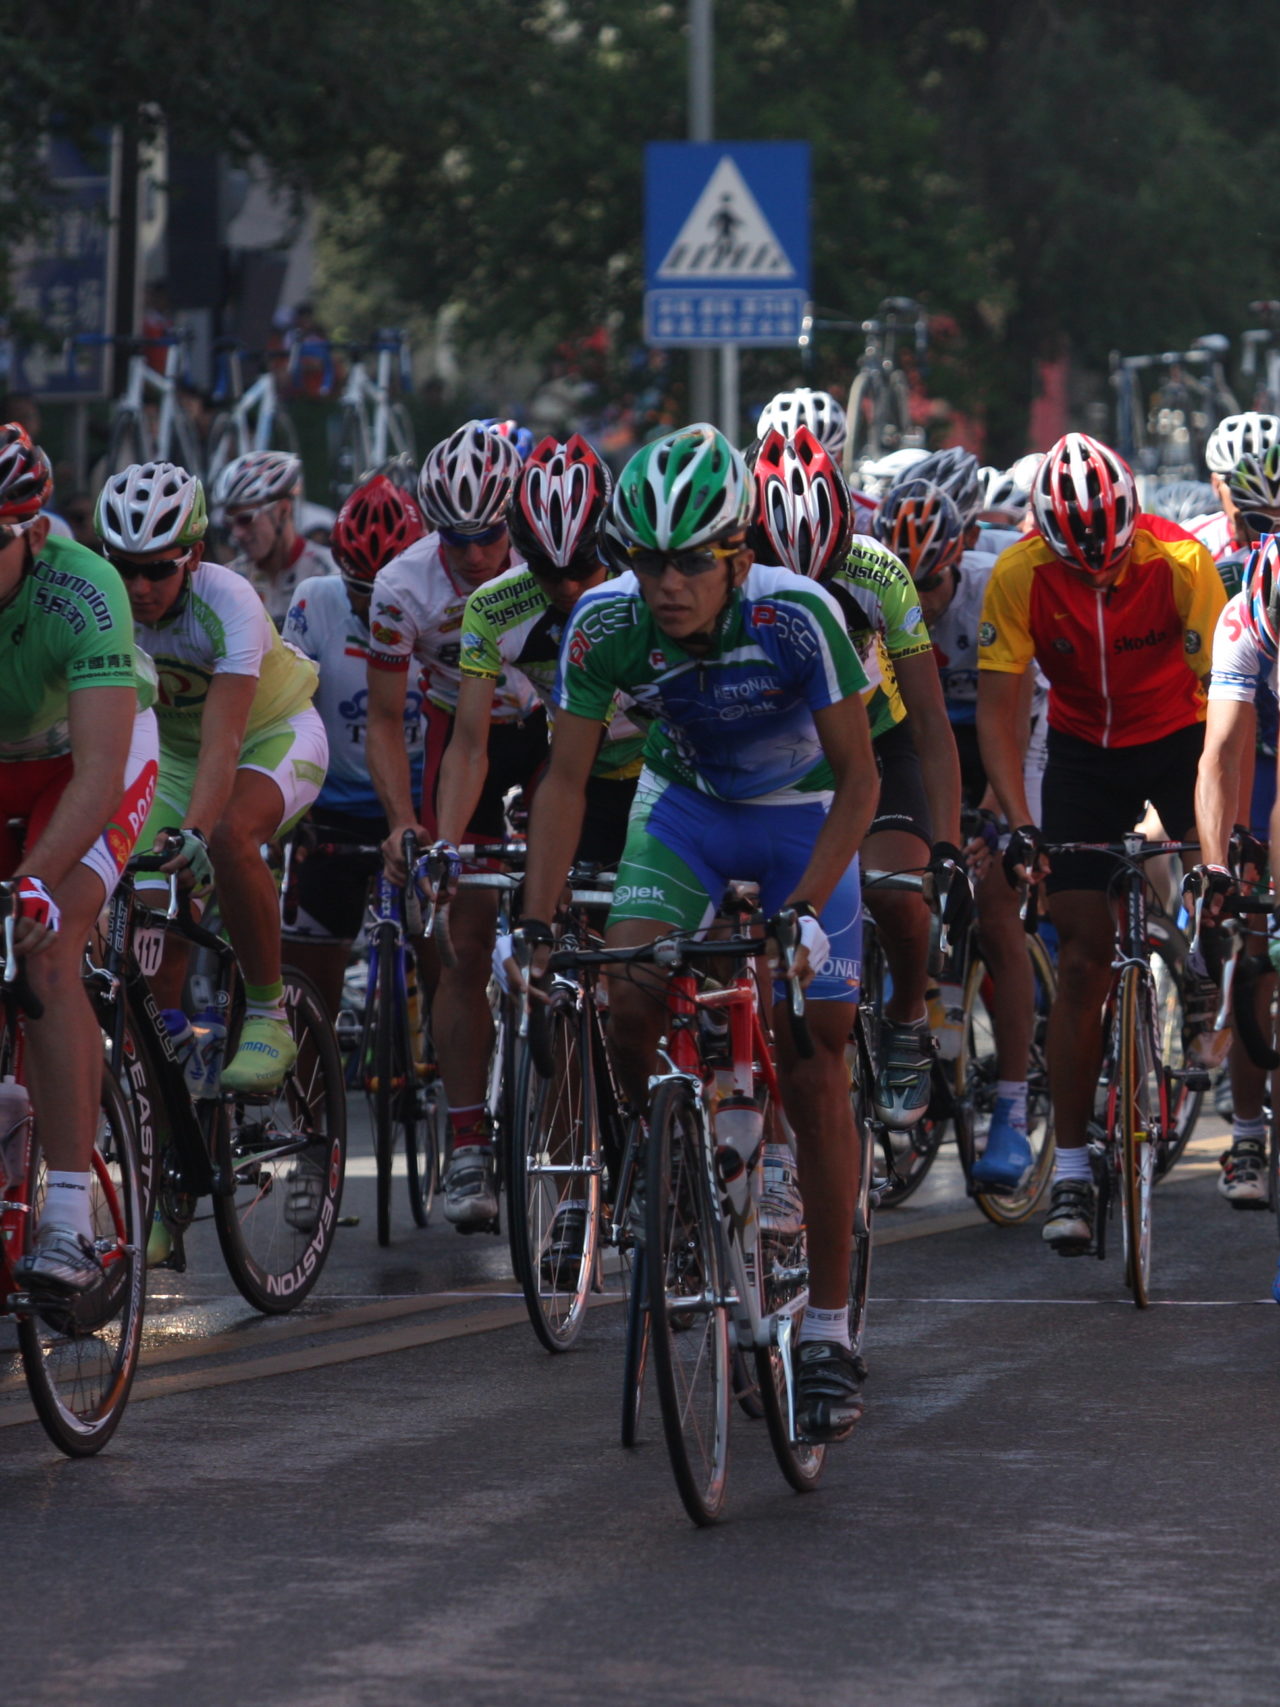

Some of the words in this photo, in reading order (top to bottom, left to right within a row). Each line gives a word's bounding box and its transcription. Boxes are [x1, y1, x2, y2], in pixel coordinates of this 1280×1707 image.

[33, 559, 113, 632] Champion
[34, 586, 87, 635] System
[484, 592, 546, 627] System
[137, 935, 162, 971] 117
[266, 1196, 335, 1296] EASTON
